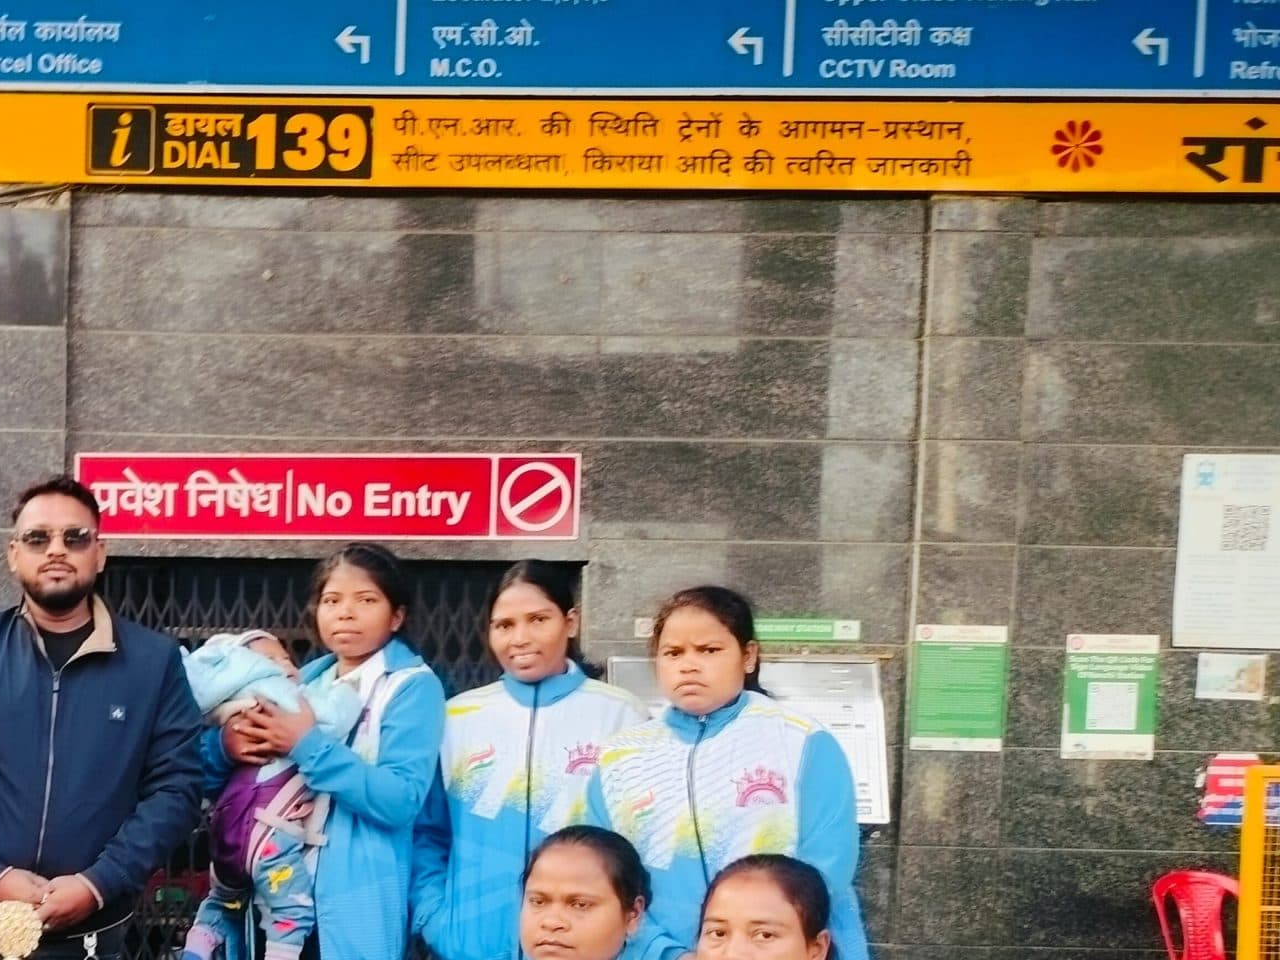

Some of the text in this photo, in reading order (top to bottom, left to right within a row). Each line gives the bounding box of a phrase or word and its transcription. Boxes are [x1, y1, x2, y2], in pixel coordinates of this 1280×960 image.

[33, 15, 122, 42] कार्यालय
[432, 18, 540, 49] एम.सी.ओ.
[821, 19, 973, 48] सीसीटीवी कक्ष
[37, 52, 102, 74] Office
[430, 58, 503, 78] M.C.O.
[819, 59, 956, 79] CCTV Room
[163, 111, 244, 137] डायल
[393, 109, 521, 139] पी.एन.आर.
[540, 111, 571, 137] की
[588, 111, 660, 138] स्थिति
[677, 111, 723, 143] ट्रेनों
[738, 112, 762, 139] के
[162, 141, 241, 170] DIAL
[245, 112, 370, 171] 139
[1181, 116, 1280, 183] रां
[392, 145, 439, 172] सीट
[584, 147, 664, 174] किराया
[676, 148, 732, 178] आदि
[743, 148, 776, 175] की
[784, 149, 856, 175] त्वरित
[866, 149, 973, 177] जानकारी
[90, 467, 285, 519] प्रवेश निषेध
[297, 482, 471, 526] No Entry
